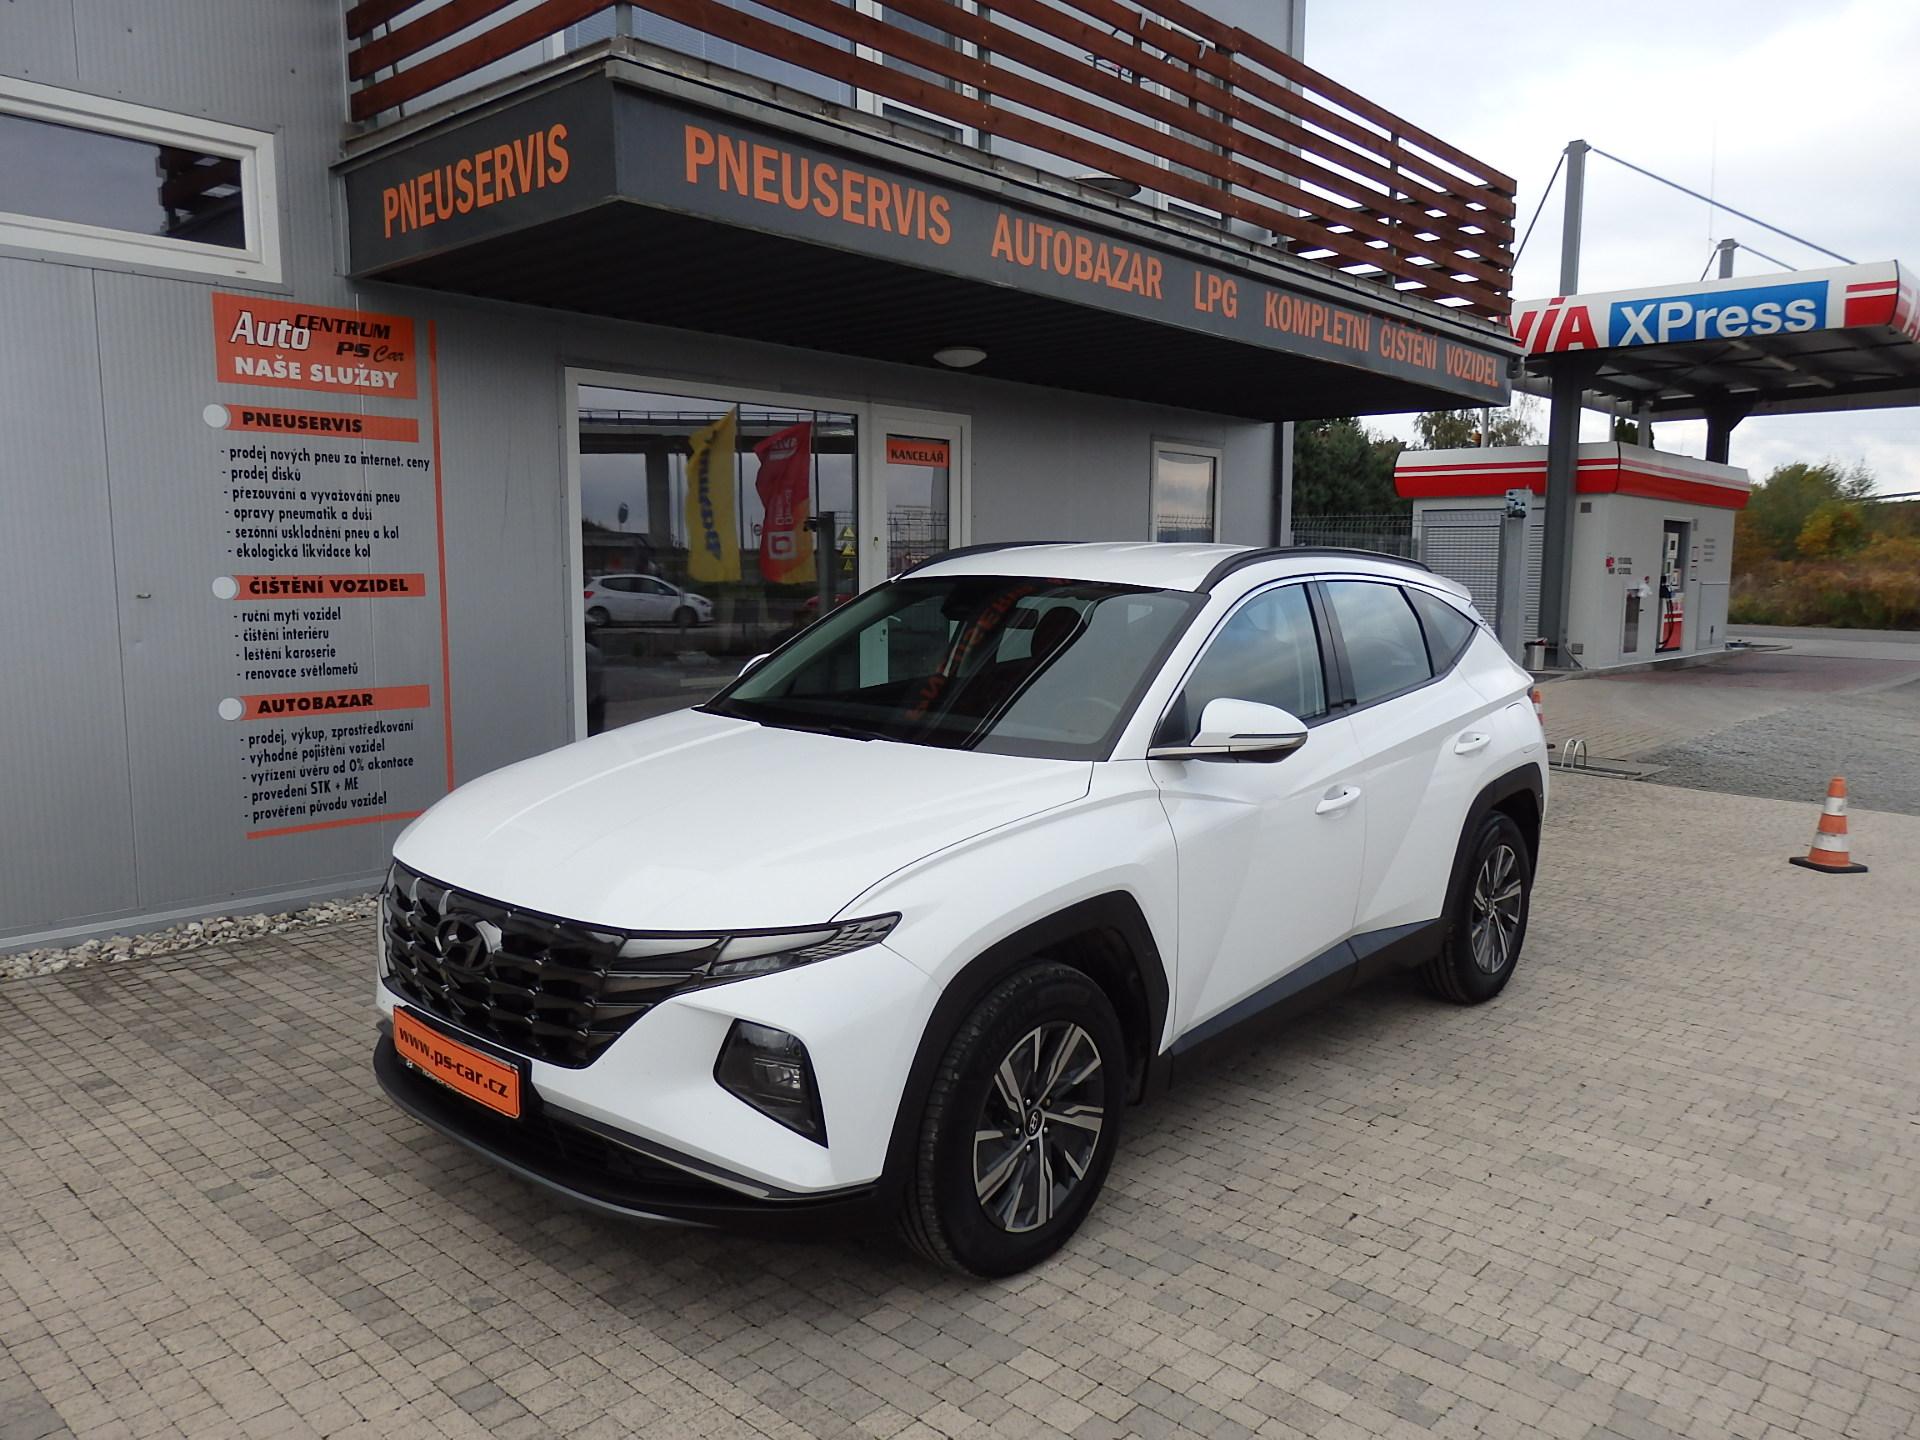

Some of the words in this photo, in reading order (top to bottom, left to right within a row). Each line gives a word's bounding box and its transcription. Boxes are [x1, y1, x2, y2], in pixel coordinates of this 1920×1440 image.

[383, 123, 569, 239] PNEUSERVIS
[684, 124, 951, 245] PNEUSERVIS
[990, 212, 1163, 300] AUTOBAZAR
[1193, 269, 1238, 319] LPG
[1264, 290, 1372, 352] KOMPLETNÍ
[1379, 317, 1439, 370] ČIŠTĚNÍ
[1446, 343, 1499, 388] VOZIDEL
[229, 310, 312, 351] Auto
[295, 313, 392, 340] CENTRUM
[1617, 298, 1817, 347] XPress
[336, 341, 371, 358] PS
[234, 354, 302, 381] NAŠE
[309, 362, 400, 390] SLUŽBY
[242, 411, 363, 433] PNEUSERVIS
[229, 444, 267, 464] prodej
[270, 447, 311, 465] nových
[314, 452, 341, 466] pneu
[344, 454, 357, 464] za
[360, 451, 404, 468] internet.
[406, 458, 430, 472] ceny
[891, 448, 944, 464] KANCELÁŘ
[231, 464, 268, 484] prodej
[272, 466, 301, 481] disků
[232, 486, 296, 503] přezouvání
[300, 491, 307, 500] a
[311, 489, 373, 504] vyvažování
[375, 492, 401, 506] pneu
[233, 508, 274, 523] opravy
[278, 506, 337, 523] pneumatik
[341, 511, 348, 520] a
[235, 525, 278, 538] sezónní
[281, 524, 342, 539] uskladnění
[344, 529, 370, 542] pneu
[373, 530, 380, 539] a
[383, 525, 399, 539] kol
[236, 543, 299, 562] ekologická
[302, 543, 351, 558] likvidace
[354, 543, 371, 558] kol
[249, 576, 324, 595] ČIŠTĚNÍ
[329, 578, 409, 593] VOZIDEL
[242, 609, 270, 622] ruční
[303, 606, 341, 621] vozidel
[243, 627, 279, 642] čištění
[282, 626, 329, 641] interiéru
[244, 646, 282, 661] leštění
[285, 643, 336, 659] karoserie
[245, 668, 297, 680] renovace
[300, 662, 359, 678] světlometů
[257, 693, 374, 714] AUTOBAZAR
[248, 729, 287, 749] prodej,
[291, 726, 328, 744] výkup,
[331, 719, 414, 741] zprostředkování
[250, 747, 298, 767] výhodné
[302, 743, 346, 762] pojištění
[349, 738, 385, 754] vozidel
[251, 767, 296, 786] vyřízení
[299, 765, 329, 778] úvěru
[333, 759, 346, 774] od
[349, 757, 364, 773] 0%
[367, 756, 414, 771] akontace
[252, 784, 307, 806] provedení
[310, 780, 331, 795] STK
[344, 776, 359, 791] ME
[253, 802, 306, 824] prověření
[309, 796, 347, 817] původu
[350, 791, 387, 809] vozidel
[399, 1027, 508, 1099] www.ps-car.cz
